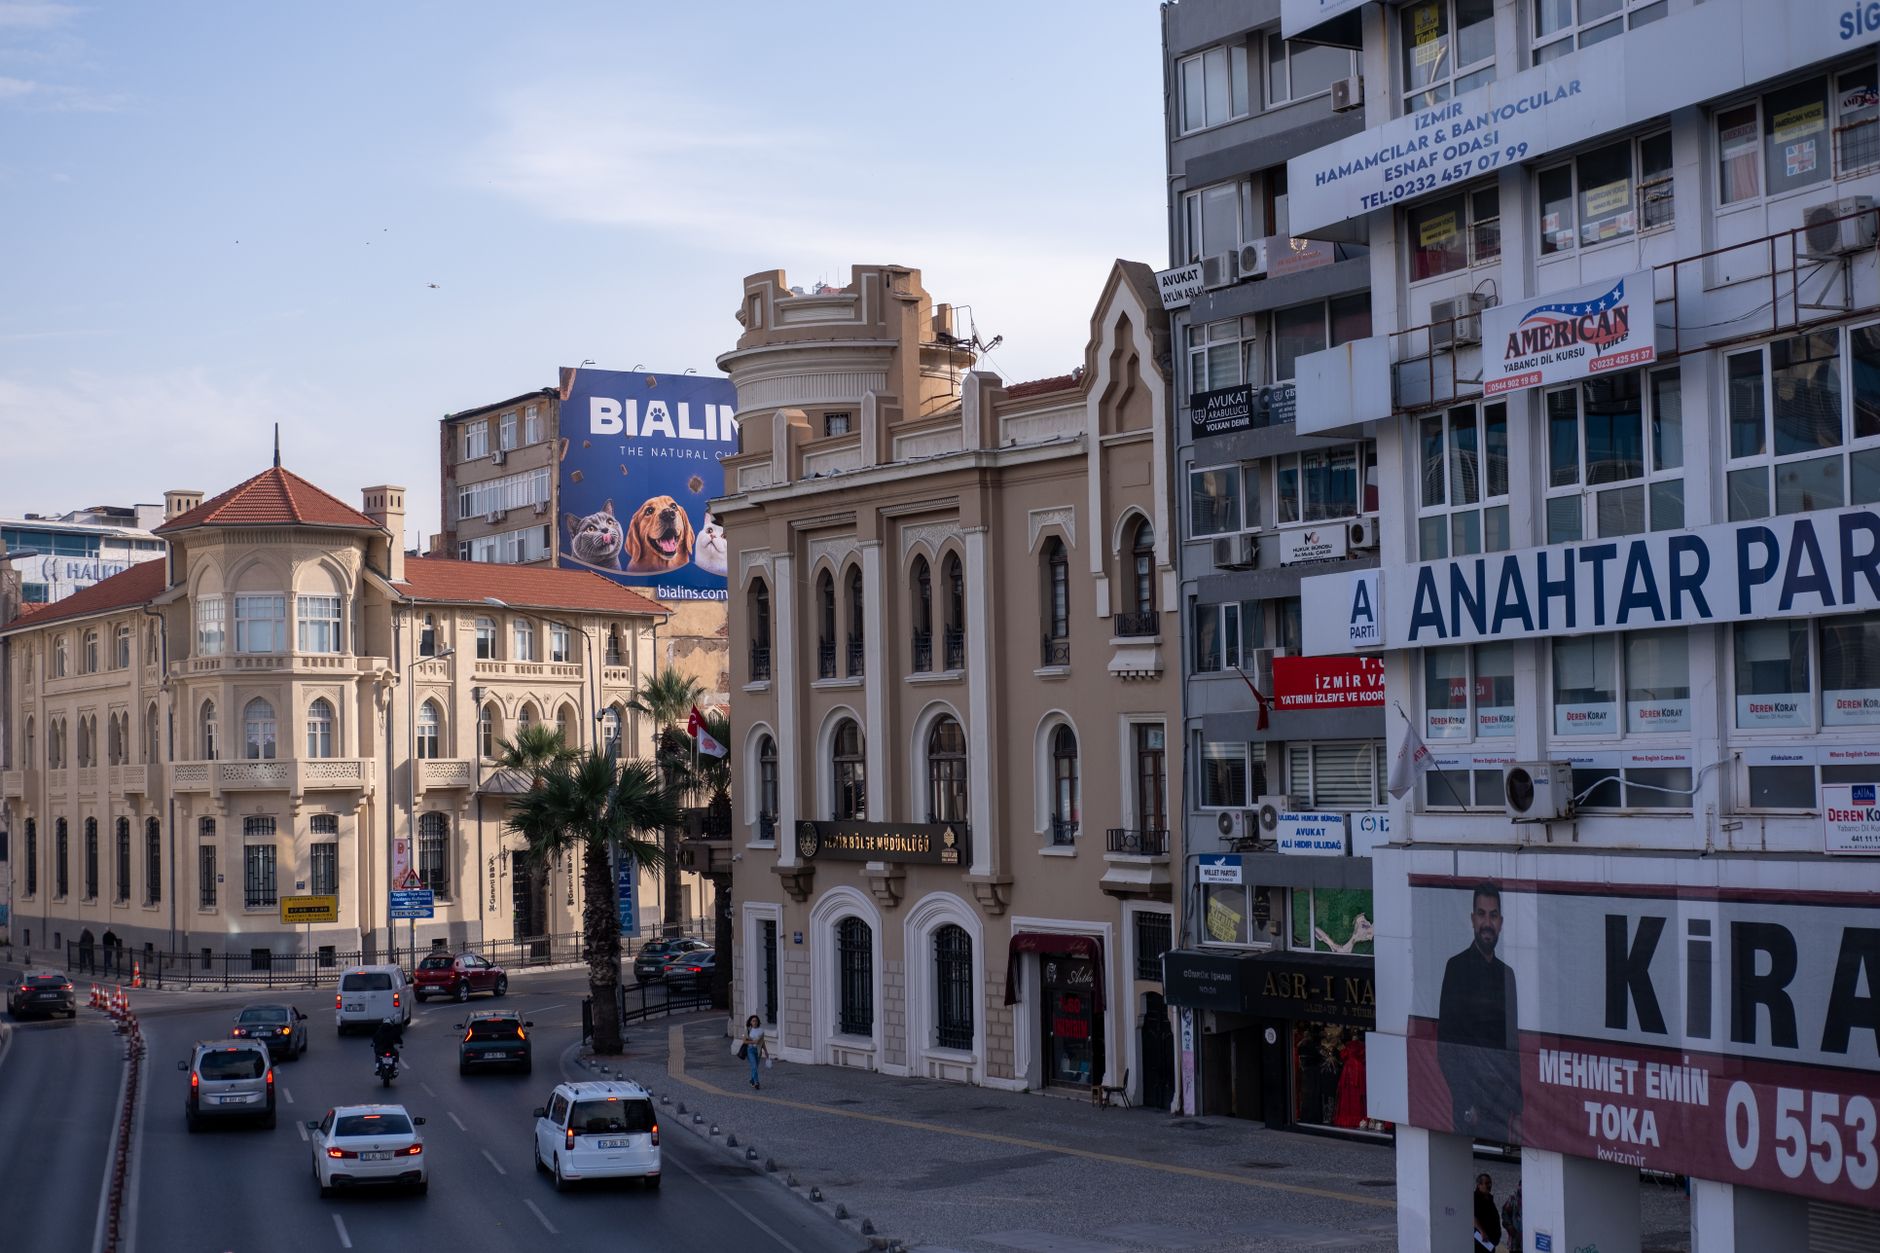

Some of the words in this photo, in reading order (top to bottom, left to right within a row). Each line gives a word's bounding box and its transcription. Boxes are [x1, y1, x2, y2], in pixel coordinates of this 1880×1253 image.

[1415, 101, 1463, 131] İZMİR
[1315, 134, 1429, 187] HAMAMCILAR
[1434, 129, 1447, 144] &
[1452, 79, 1582, 139] BANYOCULAR
[1384, 150, 1438, 183] ESNAF
[1443, 131, 1499, 161] ODASI
[1360, 173, 1436, 211] TEL:0232
[1441, 159, 1472, 183] 457
[1477, 151, 1500, 171] 07
[1505, 141, 1528, 162] 99
[1162, 269, 1198, 288] AVUKAT
[1163, 289, 1184, 304] AYLİN
[1504, 305, 1630, 361] AMERICAN
[1504, 357, 1539, 374] YABANCI
[1541, 353, 1553, 366] DİL
[1556, 347, 1585, 363] KURSU
[1597, 357, 1615, 369] 0232
[1616, 354, 1629, 366] 425
[1631, 352, 1640, 363] 51
[1641, 349, 1651, 361] 37
[1207, 390, 1248, 410] AVUKAT
[590, 396, 738, 441] BIALIN
[1208, 404, 1249, 420] ARABULUCU
[1206, 420, 1230, 432] VOLKAN
[1231, 416, 1250, 427] DEMİR
[619, 445, 644, 457] THE
[651, 447, 708, 460] NATURAL
[1408, 534, 1713, 641] ANAHTAR
[1736, 511, 1880, 615] PAR
[658, 585, 728, 600] bialins.com
[1350, 579, 1373, 624] A
[1315, 672, 1361, 689] İZMİR
[1281, 693, 1313, 705] YATIRIM
[1346, 692, 1357, 702] VE
[1837, 699, 1862, 709] DEREN
[1567, 712, 1586, 721] DEREN
[1587, 711, 1607, 720] KORAY
[1640, 709, 1661, 718] DEREN
[1662, 708, 1682, 717] KORAY
[1750, 704, 1773, 713] DEREN
[1774, 702, 1798, 712] KORAY
[1431, 716, 1447, 725] DEREN
[1448, 716, 1465, 725] KORAY
[1480, 715, 1498, 724] DEREN
[1320, 814, 1342, 822] BÜROSU
[1828, 808, 1864, 822] DEREN
[1296, 828, 1326, 836] AVUKAT
[849, 832, 875, 850] BÖLGE
[876, 833, 930, 853] MÜDÜRLÜĞÜ
[1281, 840, 1292, 849] ALİ
[1294, 840, 1312, 849] HIDIR
[1314, 840, 1342, 850] ULUDAĞ
[1204, 868, 1220, 876] MİLLET
[1539, 1048, 1639, 1096] MEHMET
[1646, 1055, 1709, 1107] EMİN
[1584, 1100, 1661, 1148] TOKA
[1725, 1080, 1760, 1170] 0
[1775, 1086, 1879, 1190] 553
[1597, 1144, 1647, 1168] kwizmir
